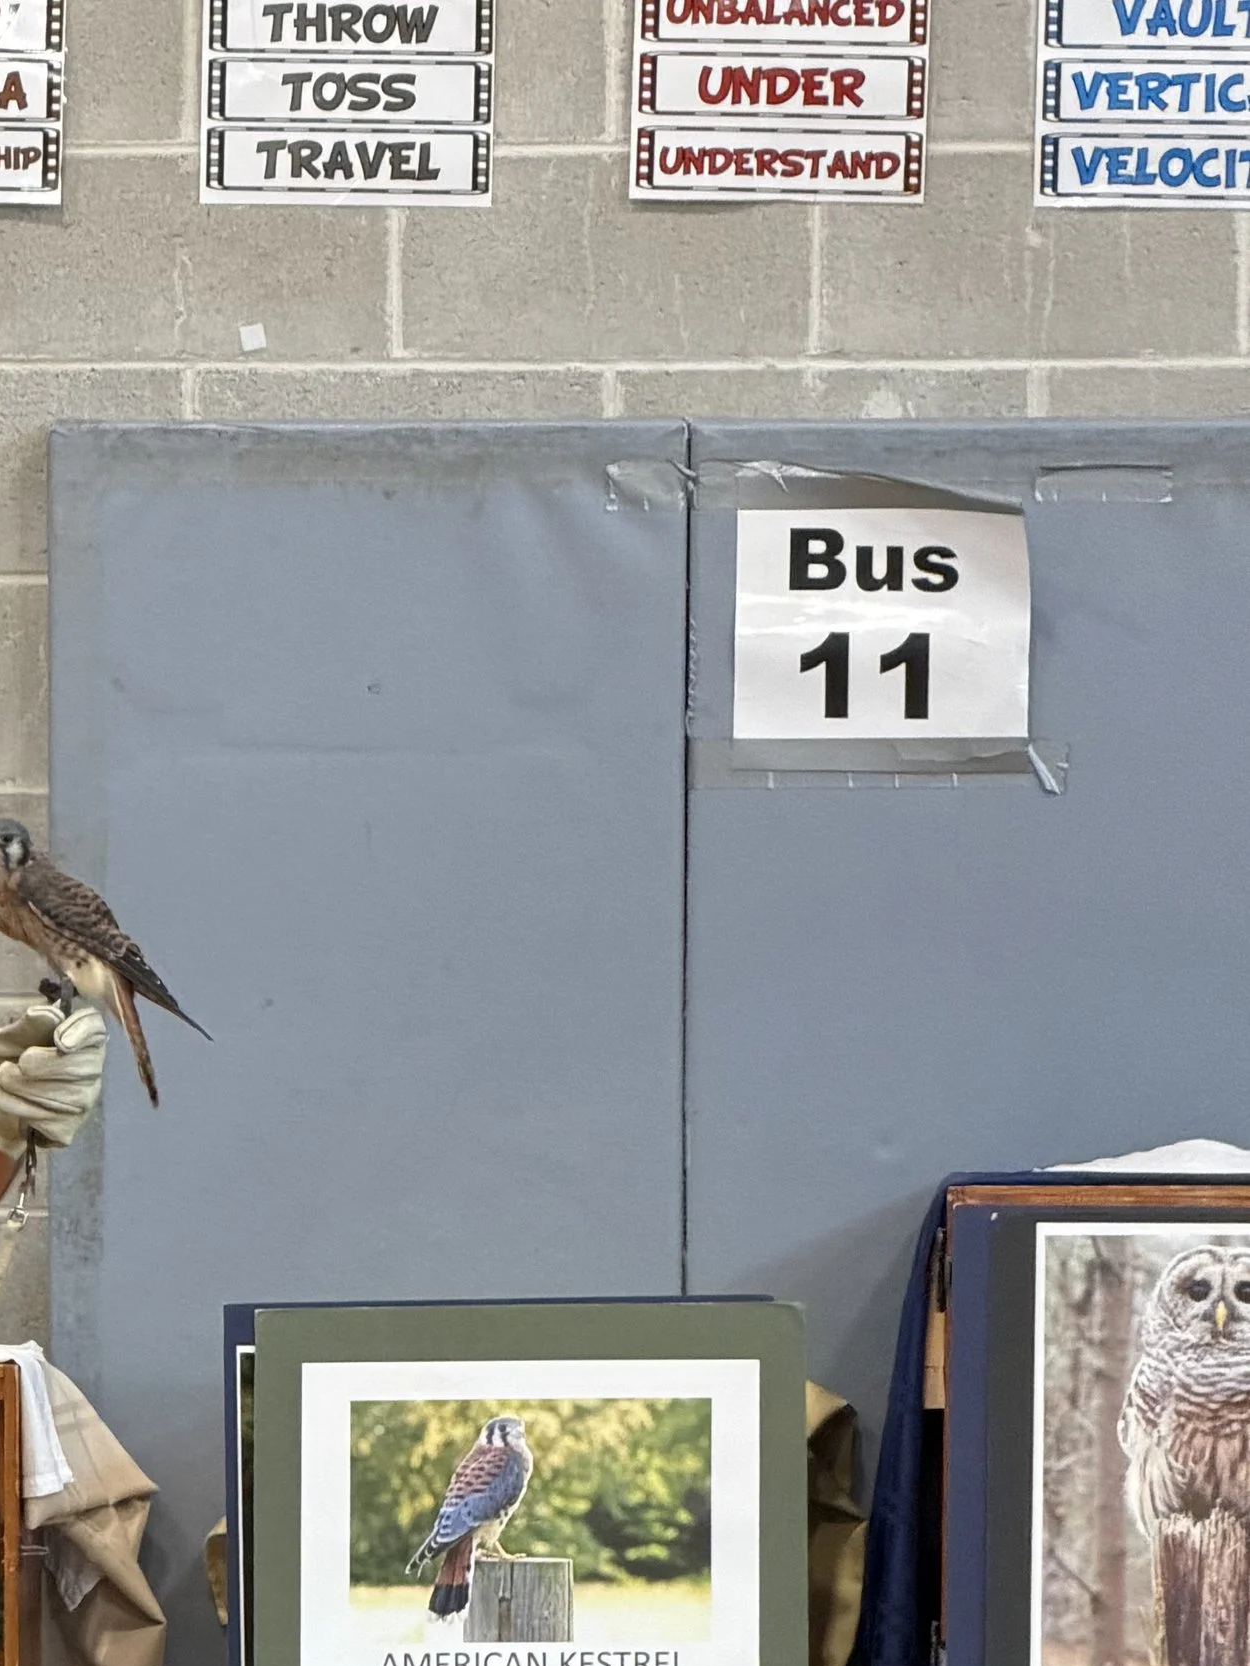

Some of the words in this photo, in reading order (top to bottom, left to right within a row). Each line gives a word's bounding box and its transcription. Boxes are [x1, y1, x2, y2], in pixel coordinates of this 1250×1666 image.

[262, 3, 439, 43] THROW
[666, 0, 905, 27] UNBALANCED
[281, 72, 416, 111] TOSS
[698, 66, 866, 108] UNDER
[1071, 71, 1250, 113] VERTIC
[256, 140, 440, 181] TRAVEL
[659, 147, 901, 179] UNDERSTAND
[789, 527, 959, 592] Bus
[800, 631, 930, 720] 11
